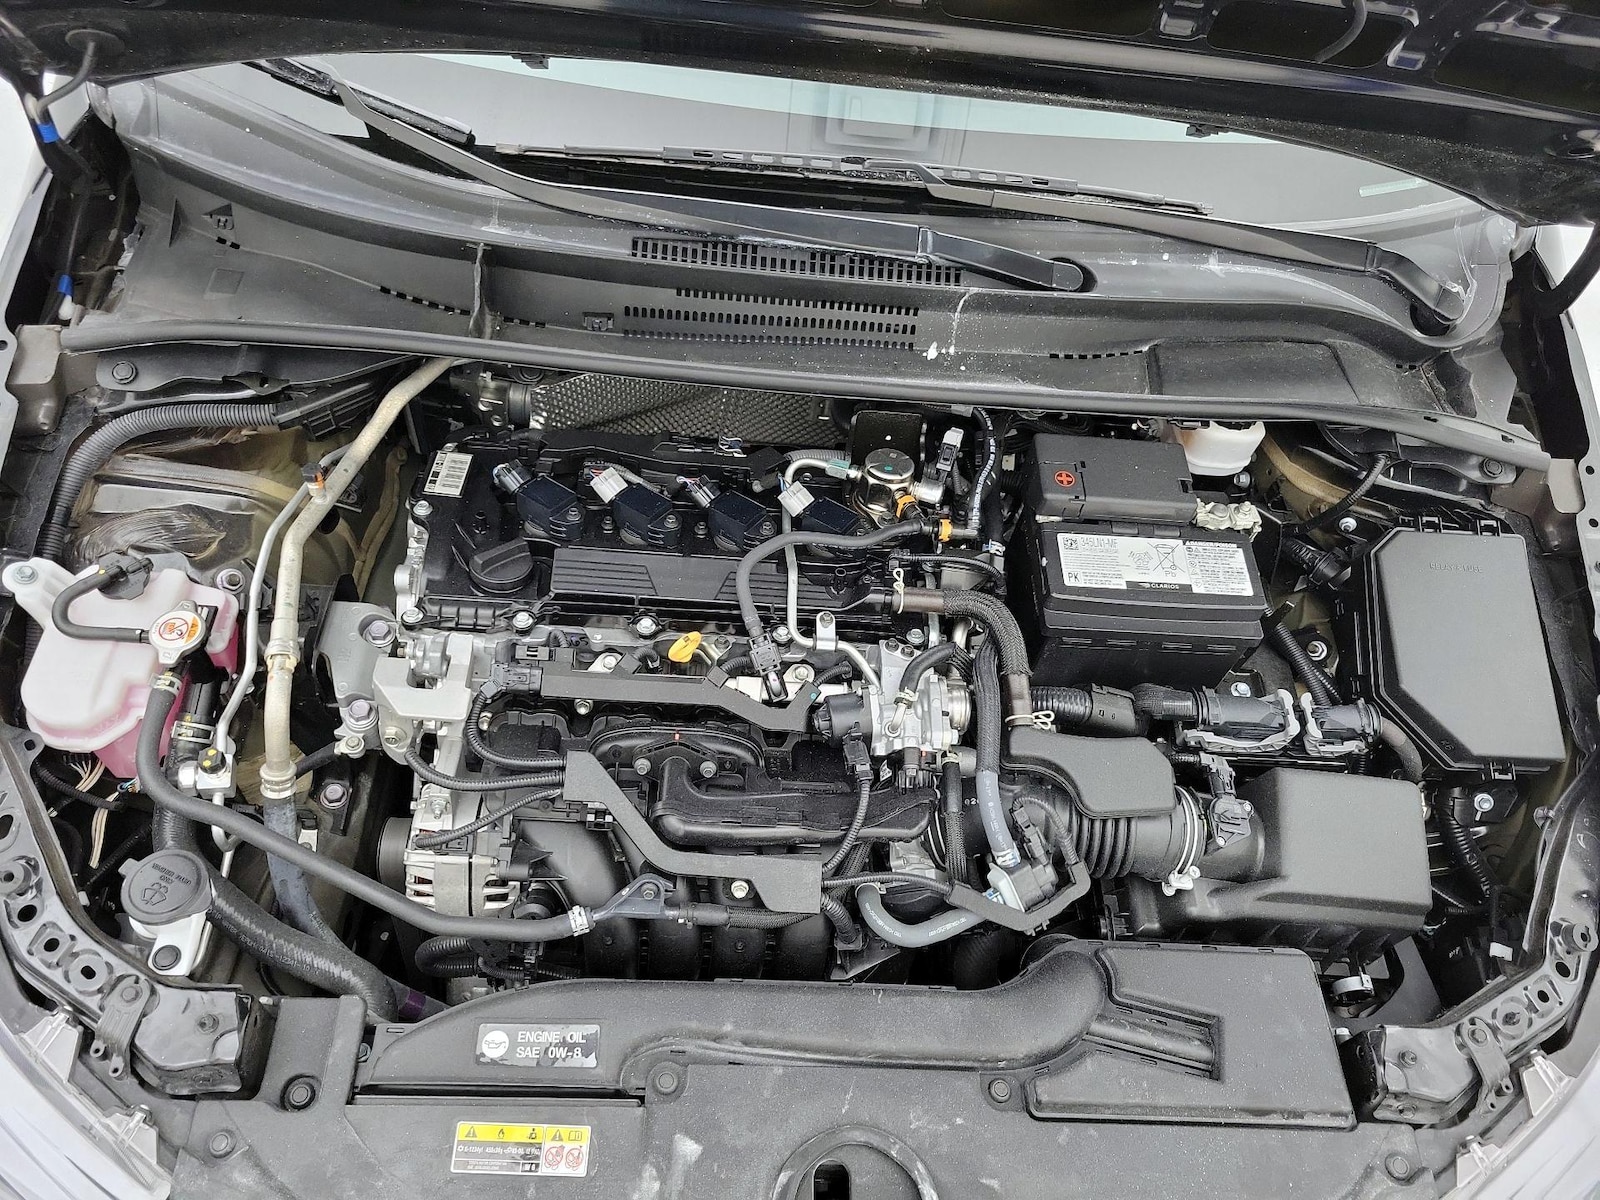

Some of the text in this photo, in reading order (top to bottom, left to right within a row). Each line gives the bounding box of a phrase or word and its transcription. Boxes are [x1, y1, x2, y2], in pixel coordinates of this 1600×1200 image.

[1067, 572, 1080, 583] PK
[1164, 570, 1177, 578] Pb
[517, 1030, 587, 1043] ENGINE OIL
[515, 1047, 582, 1058] SAE 0W-8
